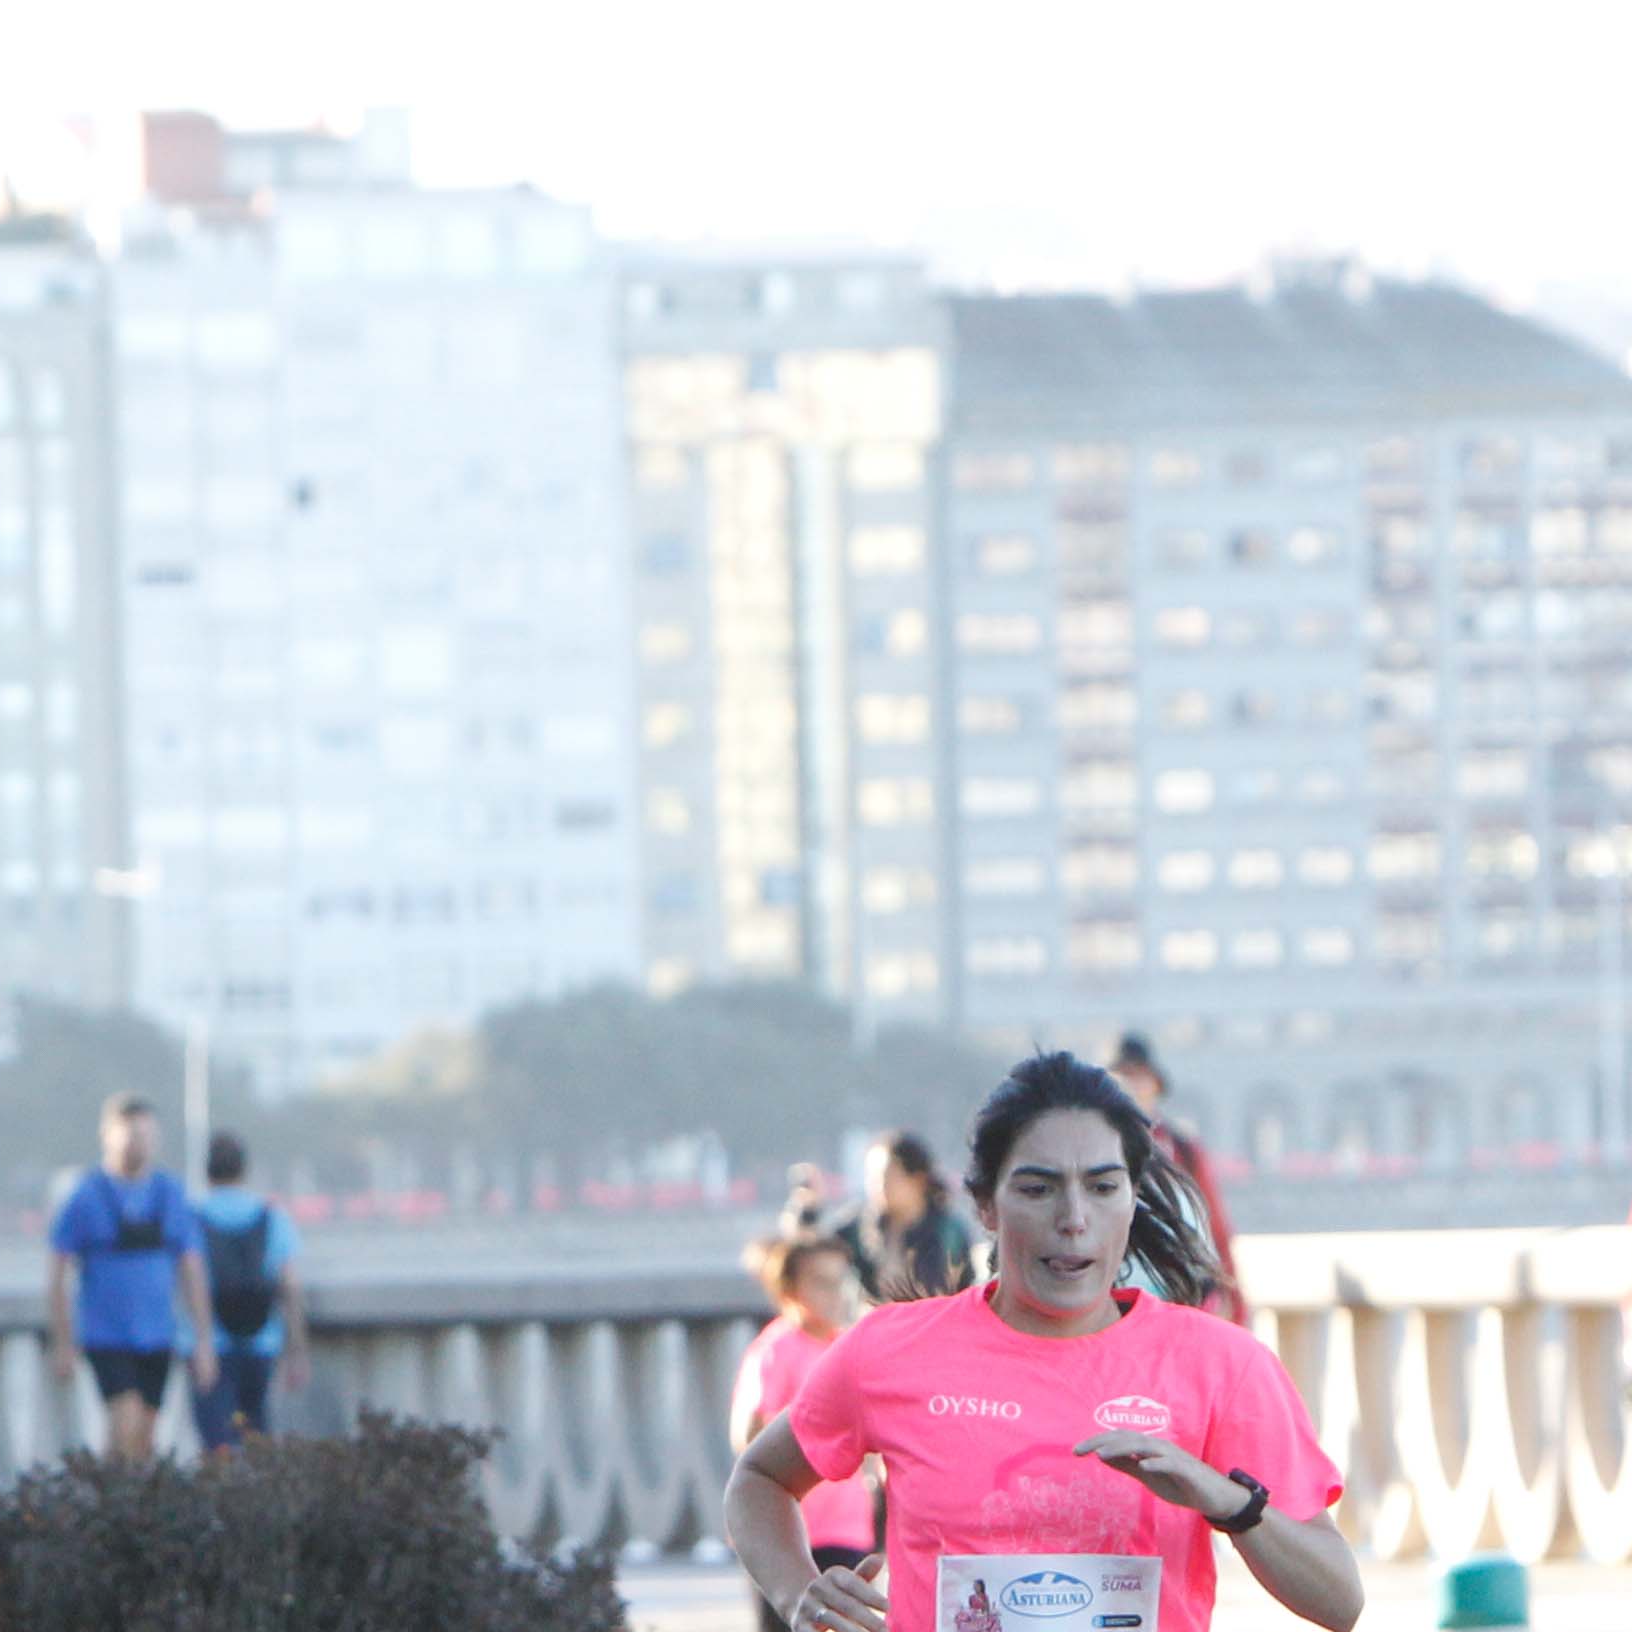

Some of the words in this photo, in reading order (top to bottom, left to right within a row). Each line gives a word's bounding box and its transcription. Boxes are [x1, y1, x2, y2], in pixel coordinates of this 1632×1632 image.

[928, 1394, 1023, 1420] OYSHO
[1101, 1580, 1143, 1592] SUMA
[1008, 1588, 1086, 1606] ASTURIANA
